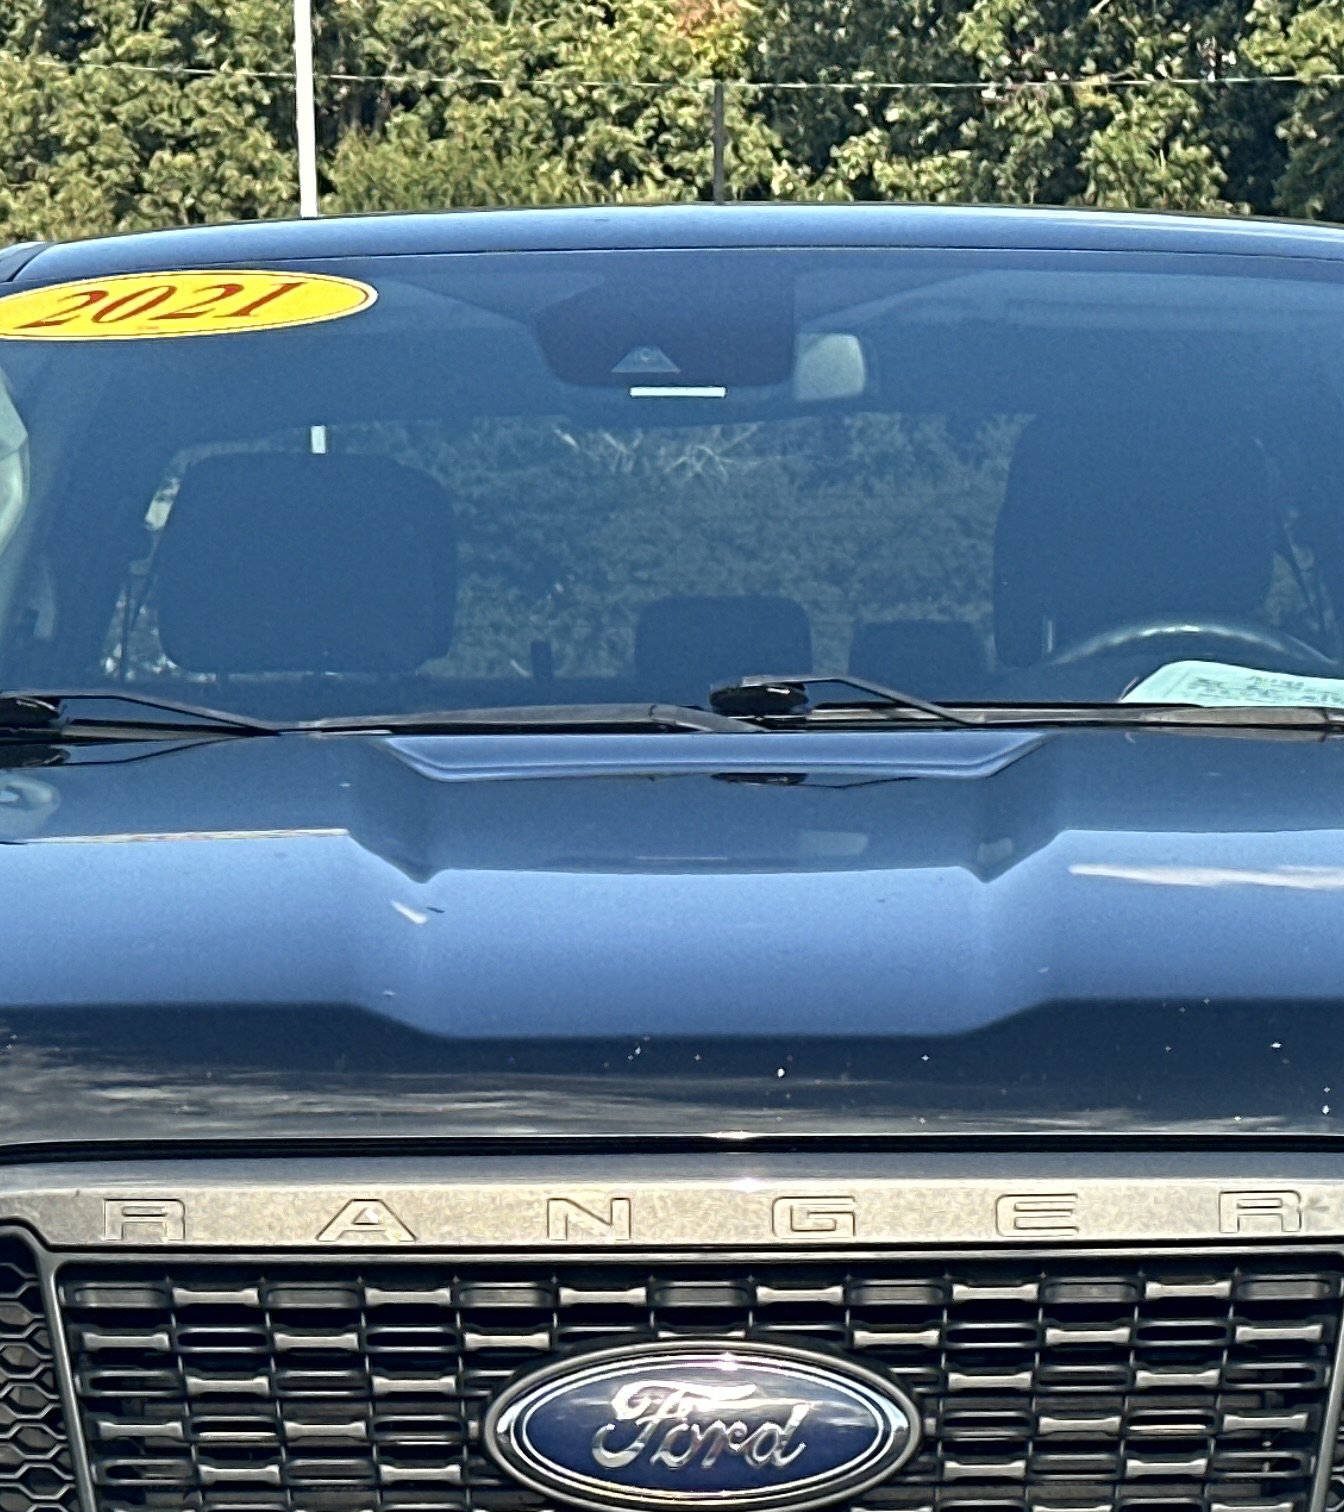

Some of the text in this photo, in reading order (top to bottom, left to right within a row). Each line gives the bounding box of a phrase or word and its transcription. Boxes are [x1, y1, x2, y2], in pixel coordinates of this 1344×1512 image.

[12, 281, 310, 330] 2021
[102, 1189, 1302, 1243] RANGER
[591, 1379, 814, 1469] Ford
